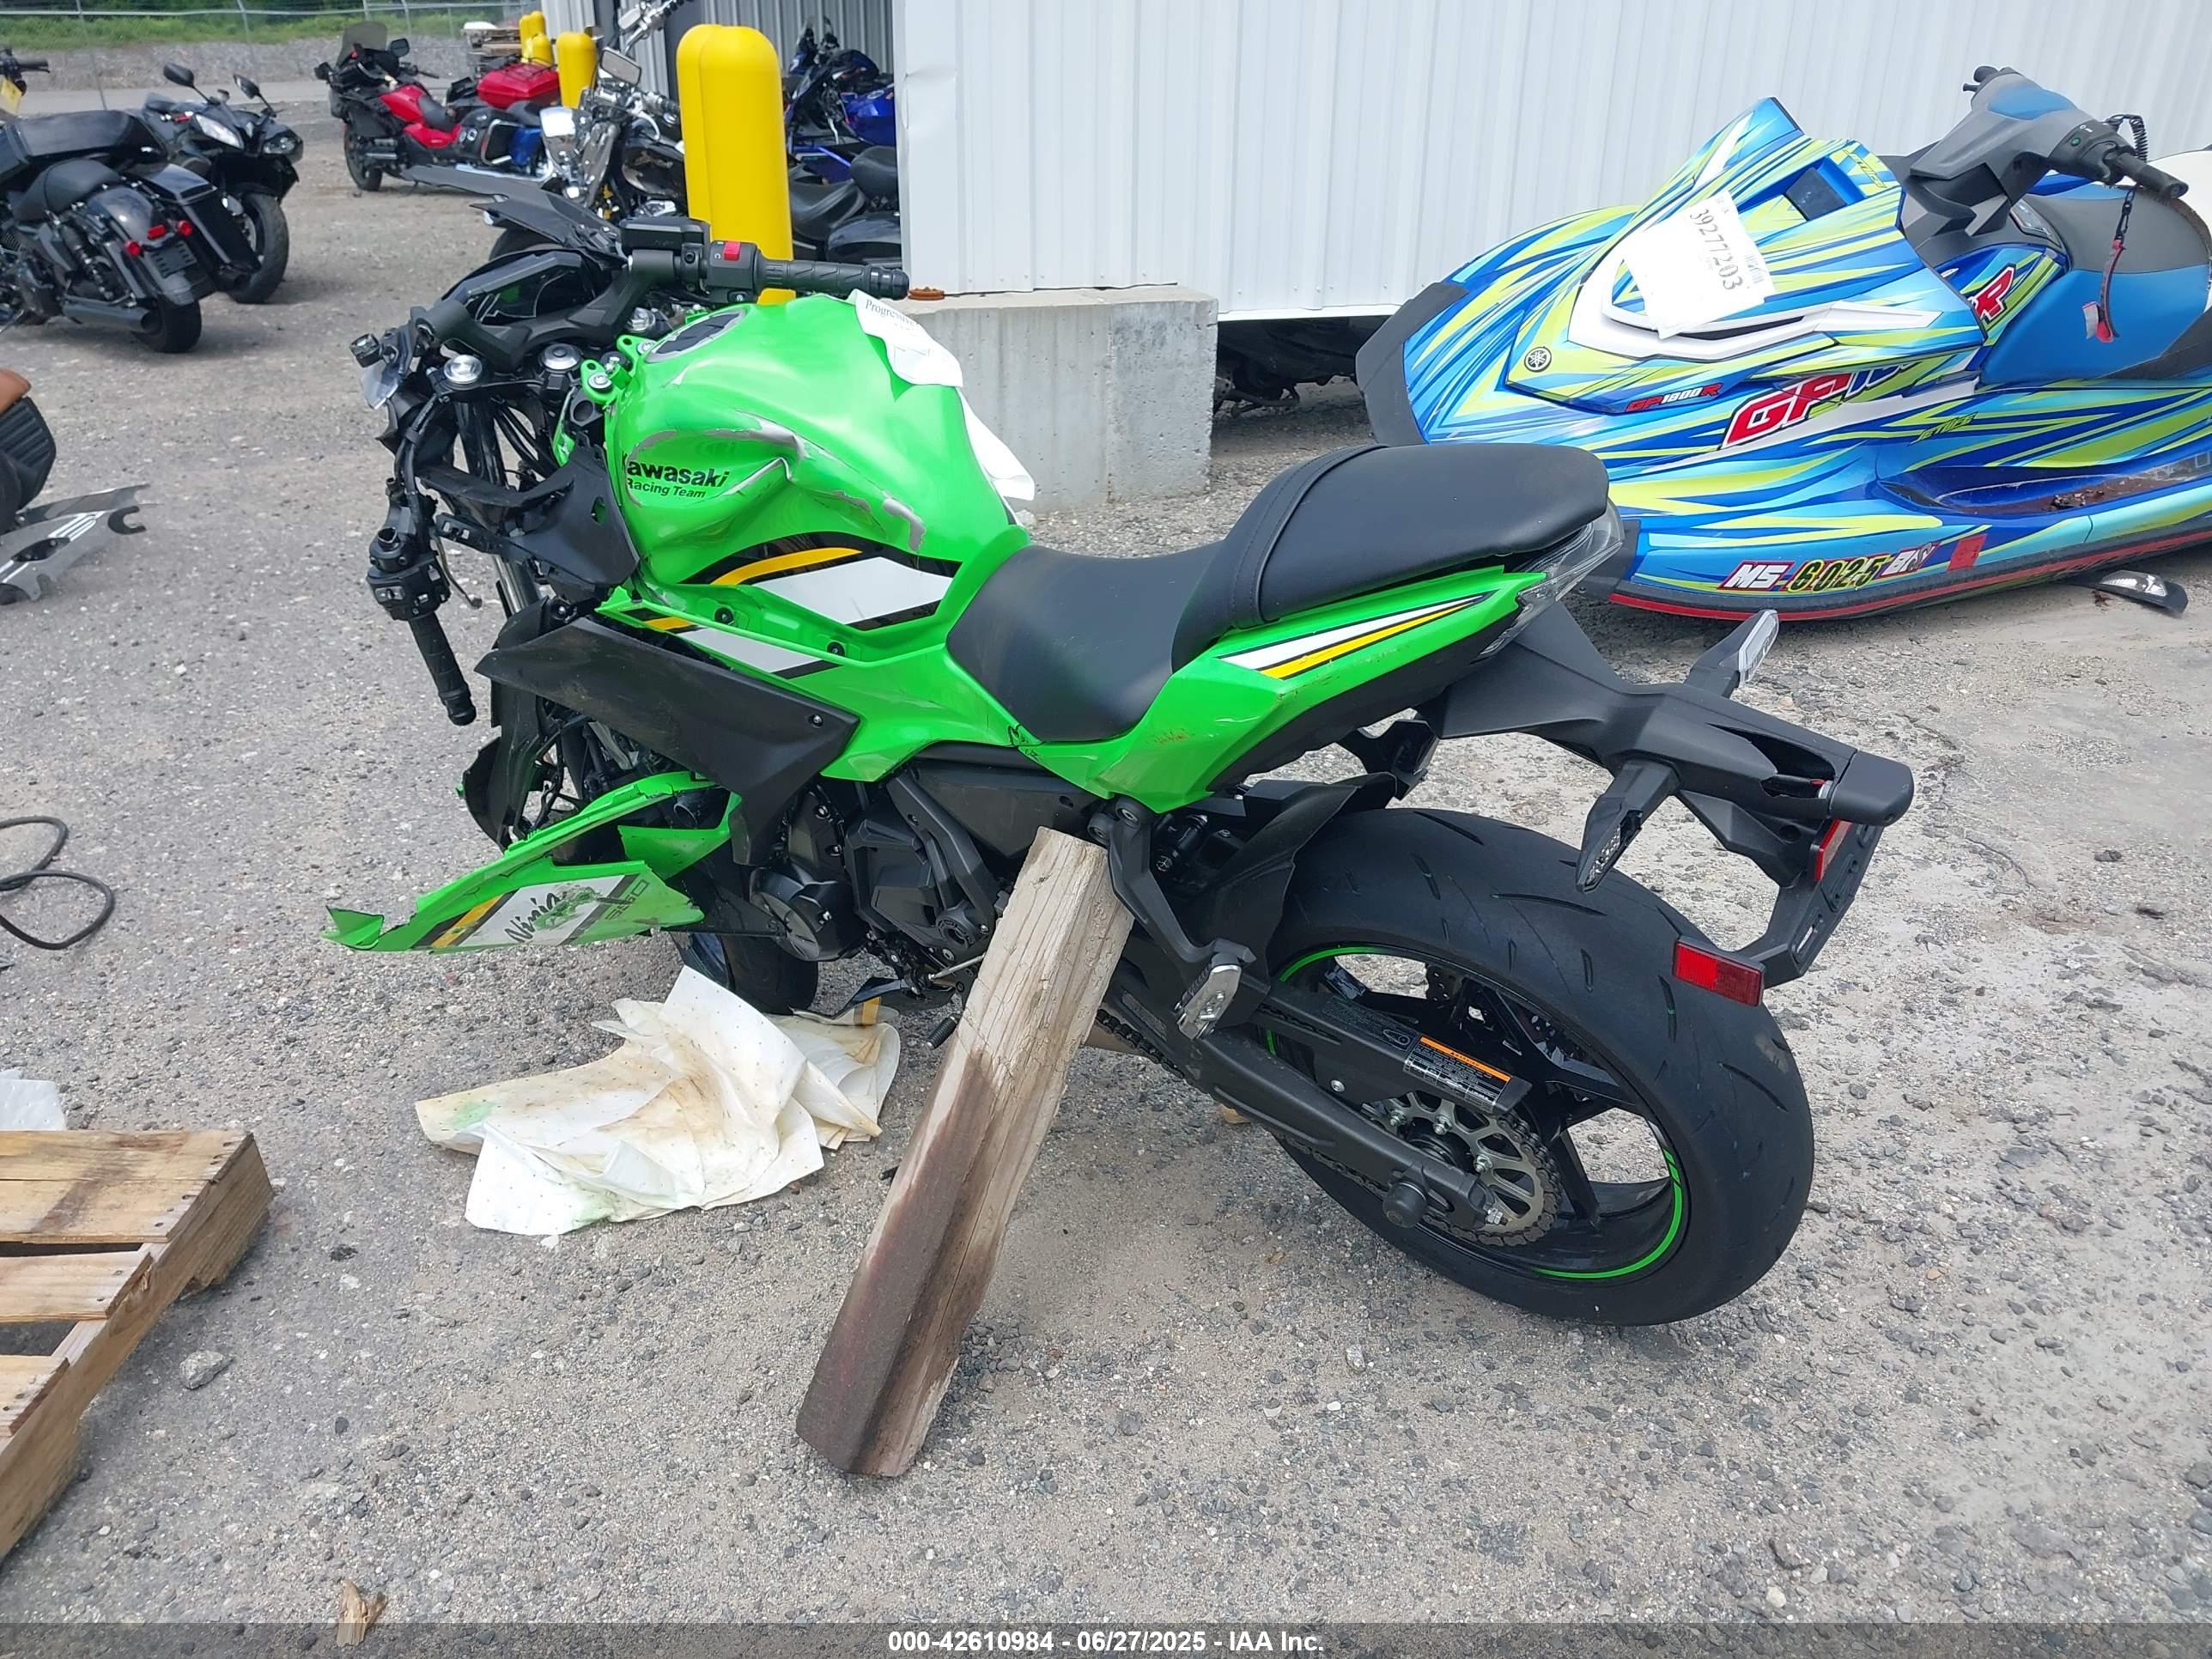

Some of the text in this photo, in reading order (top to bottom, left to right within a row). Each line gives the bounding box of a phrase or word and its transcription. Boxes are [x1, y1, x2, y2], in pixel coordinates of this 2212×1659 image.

[1689, 209, 1743, 290] 39277203
[1624, 382, 1723, 413] GP1800R
[627, 477, 706, 499] Racing Team
[1788, 555, 1892, 592] 6025
